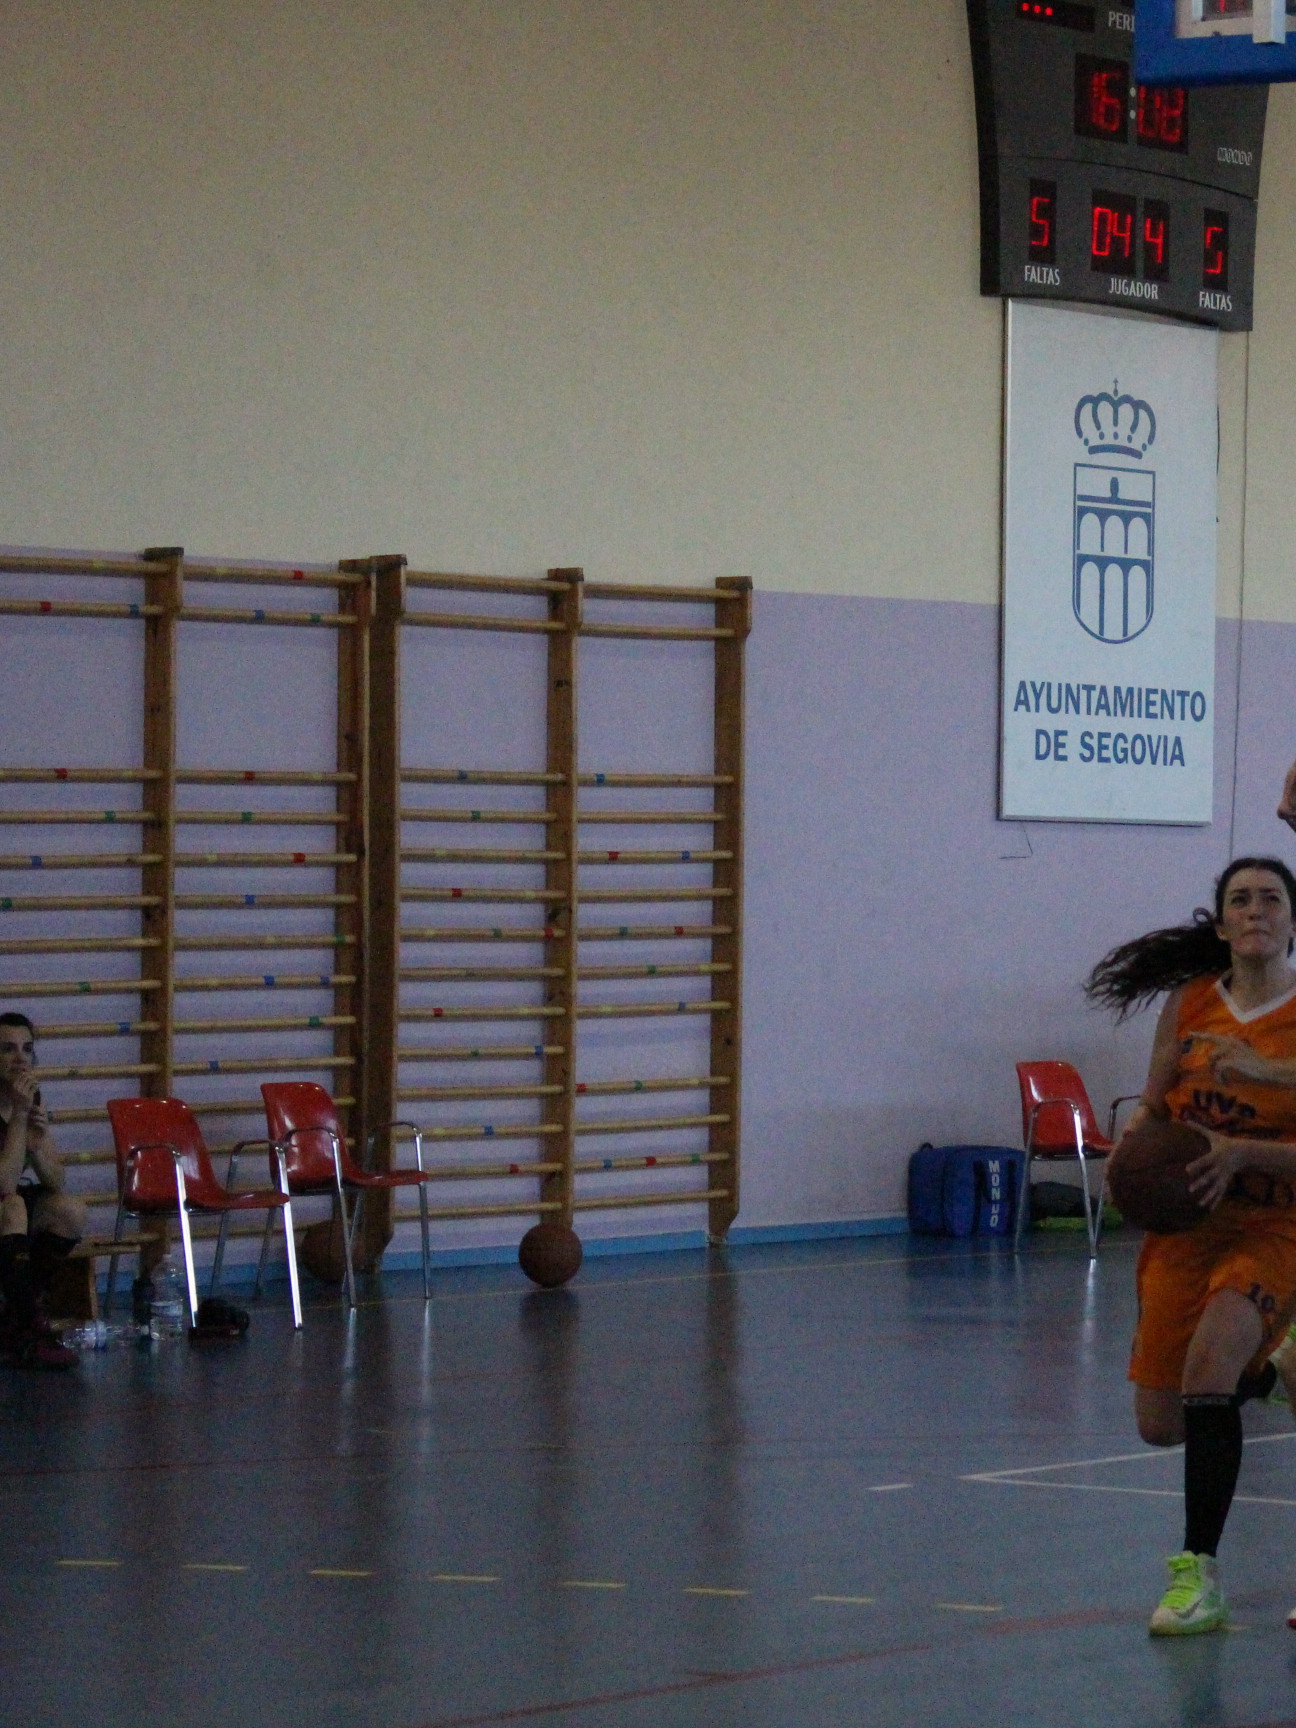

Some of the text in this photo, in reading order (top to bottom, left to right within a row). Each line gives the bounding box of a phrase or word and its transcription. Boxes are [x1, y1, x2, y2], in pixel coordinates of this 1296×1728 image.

[1217, 147, 1252, 166] MONDO
[1031, 196, 1051, 246] 5
[1204, 226, 1225, 274] 5
[1024, 264, 1061, 287] FALTAS
[1108, 277, 1159, 300] JUGADOR
[1199, 291, 1233, 312] FALTAS
[1013, 680, 1206, 722] AYUNTAMIENTO
[1035, 729, 1185, 767] DE SEGOVIA
